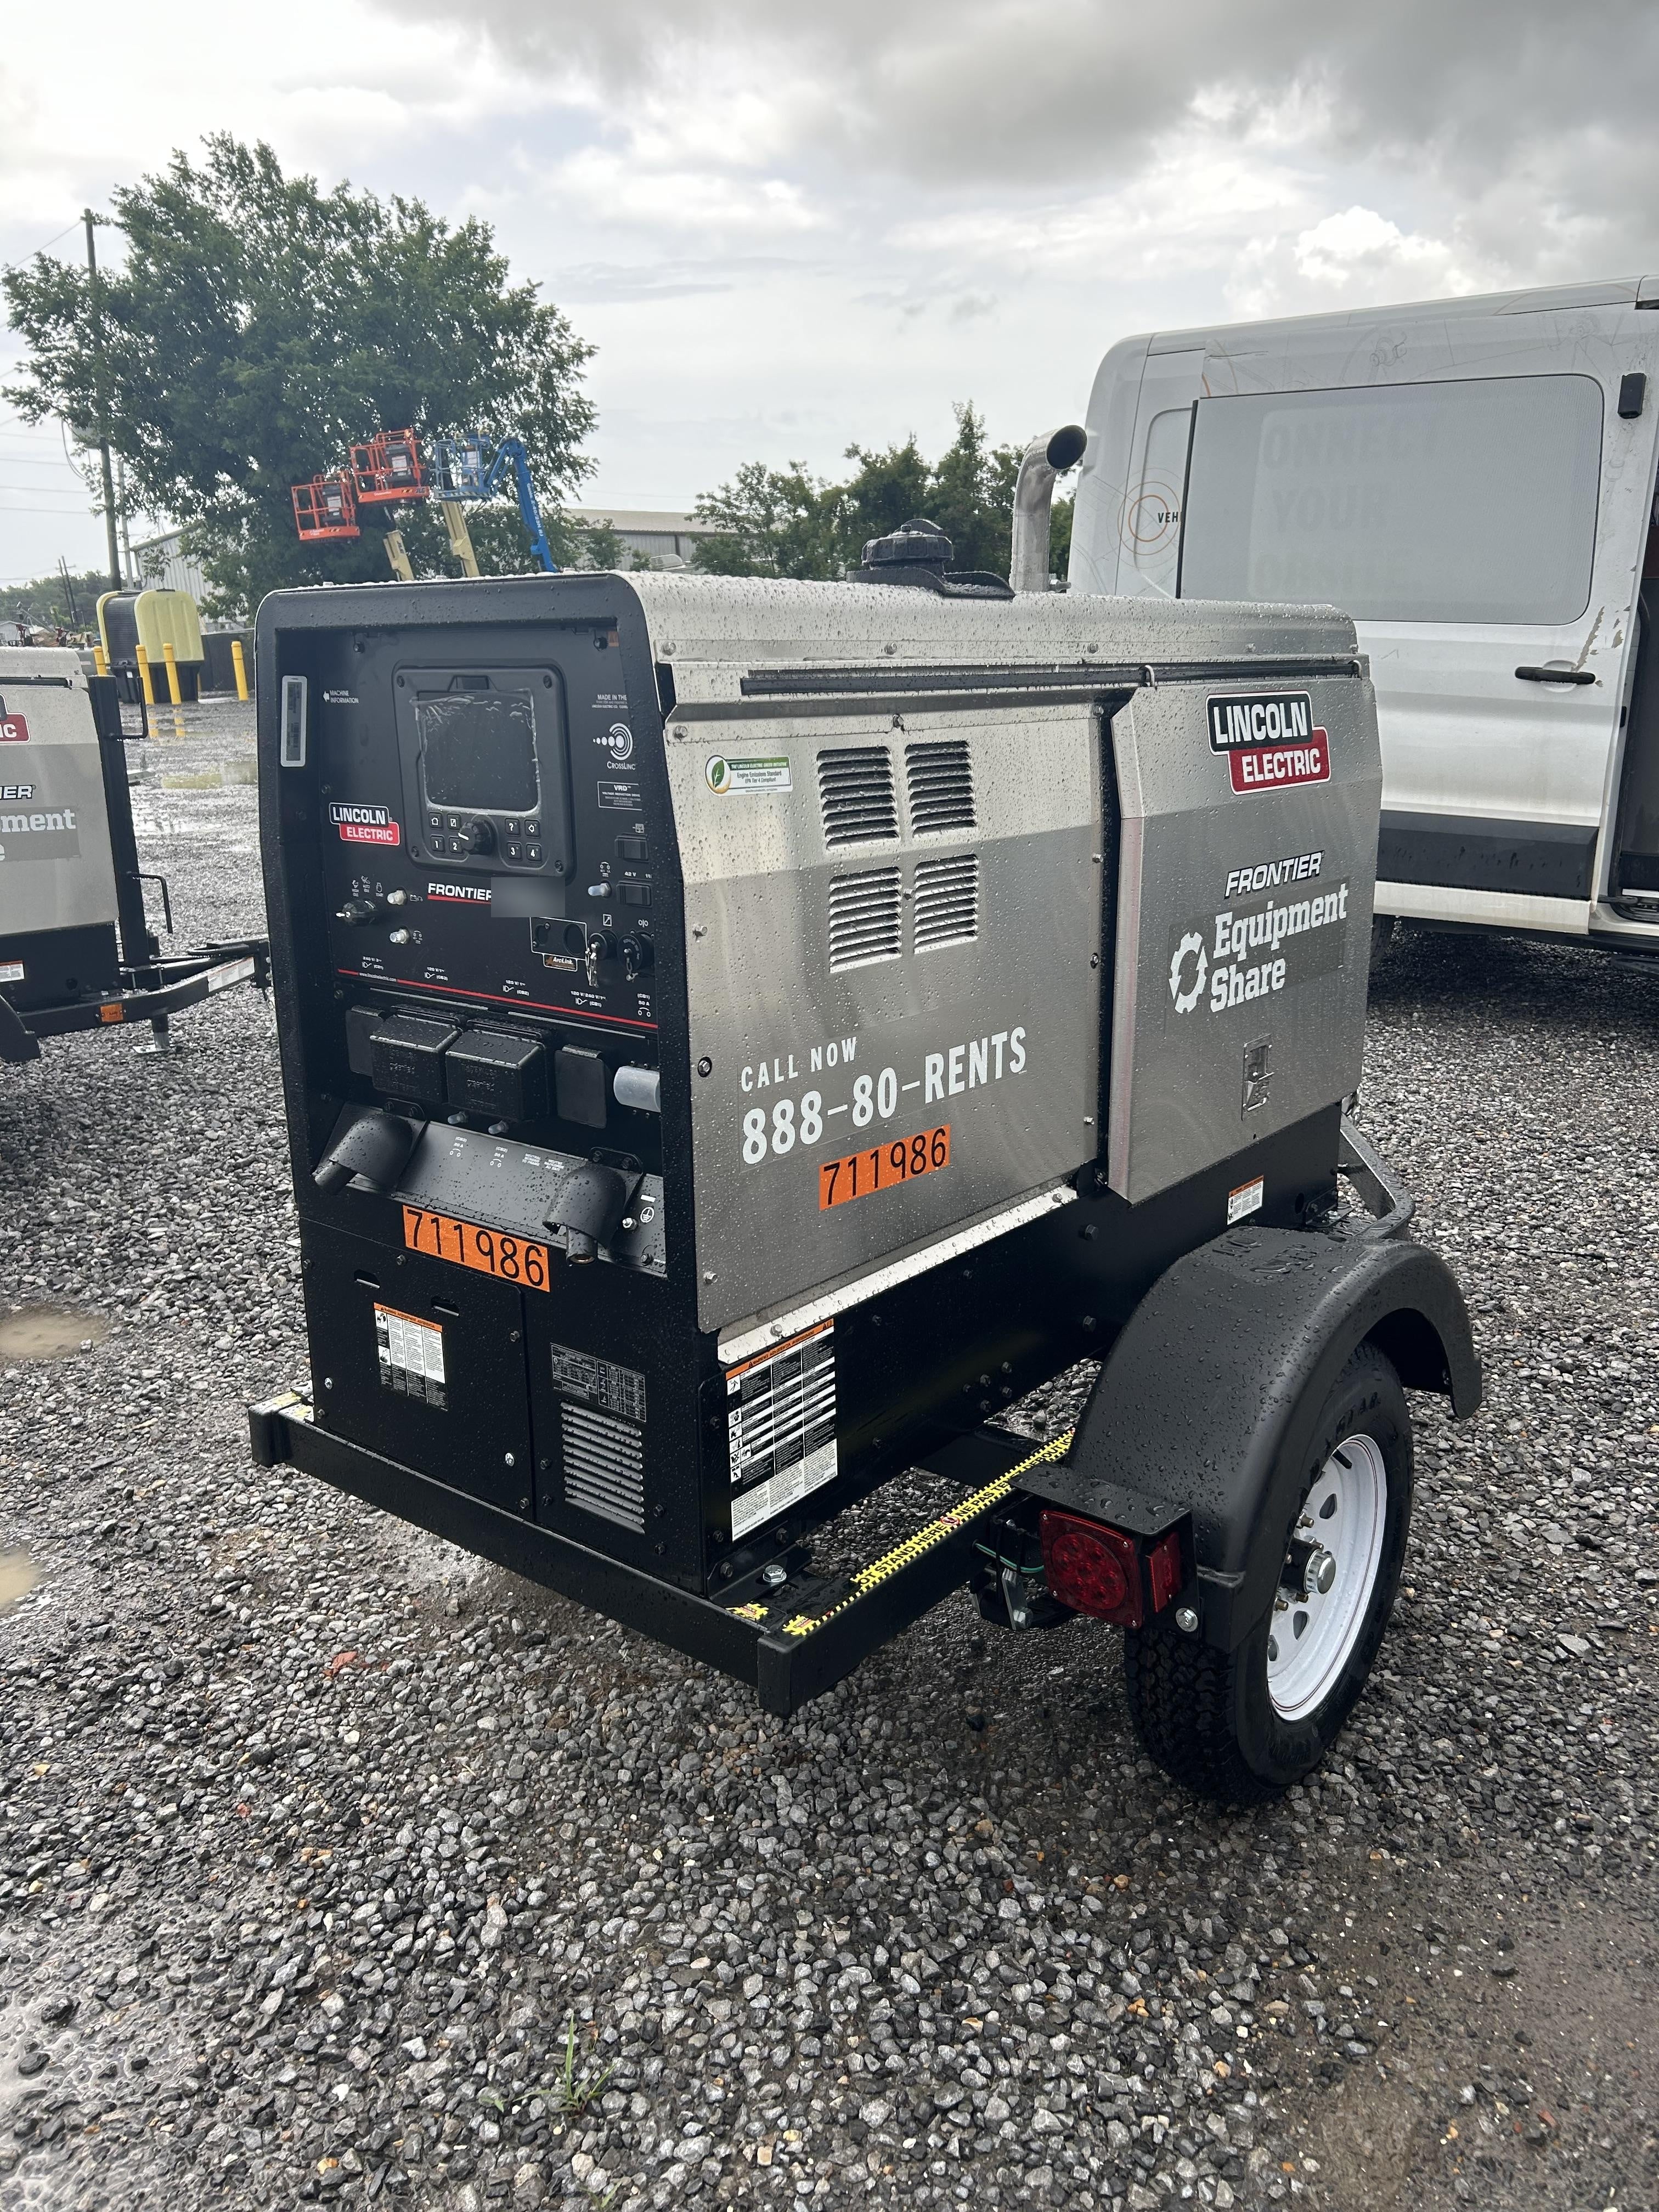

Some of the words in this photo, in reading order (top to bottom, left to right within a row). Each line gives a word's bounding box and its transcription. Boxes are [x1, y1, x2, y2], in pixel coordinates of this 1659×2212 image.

[1158, 511, 1178, 523] VEH
[1213, 701, 1308, 744] LINCOLN
[1242, 748, 1322, 783] ELECTRIC
[1, 809, 76, 833] ment
[332, 806, 386, 825] LINCOLN
[346, 826, 393, 841] ELECTRIC
[435, 840, 438, 849] 1
[453, 842, 458, 850] 2
[510, 847, 516, 856] 3
[531, 849, 535, 857] 4
[1226, 851, 1323, 899] FRONTIER
[1213, 883, 1349, 961] Equipment
[1210, 957, 1286, 1014] Share
[741, 1054, 798, 1092] CALL
[810, 1036, 857, 1071] NOW
[742, 1026, 1026, 1165] 888-80-RENTS
[823, 1128, 946, 1205] 711986
[407, 1208, 544, 1287] 711986
[956, 1505, 972, 1517] NE
[973, 1492, 995, 1506] PAS
[858, 1570, 876, 1586] OT
[876, 1545, 916, 1573] STAND
[913, 1523, 948, 1551] HERE
